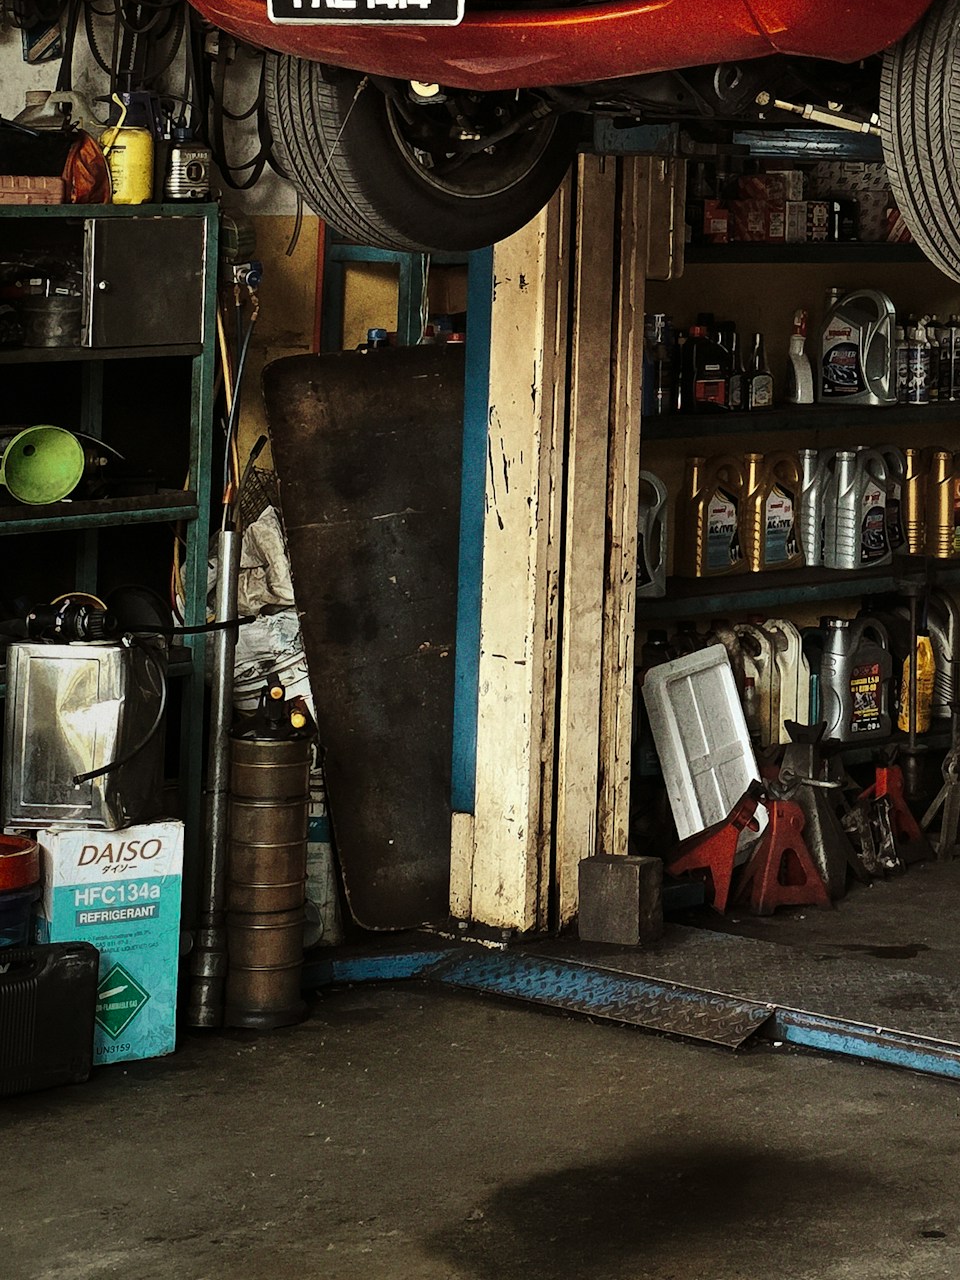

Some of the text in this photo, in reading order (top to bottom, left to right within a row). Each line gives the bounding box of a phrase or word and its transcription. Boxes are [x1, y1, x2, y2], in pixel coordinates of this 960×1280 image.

[77, 838, 163, 867] DAISO
[101, 863, 138, 875] ダイソー
[74, 882, 161, 907] HFC134a
[79, 905, 156, 924] REFRIGERANT
[96, 1042, 131, 1056] UN3159
